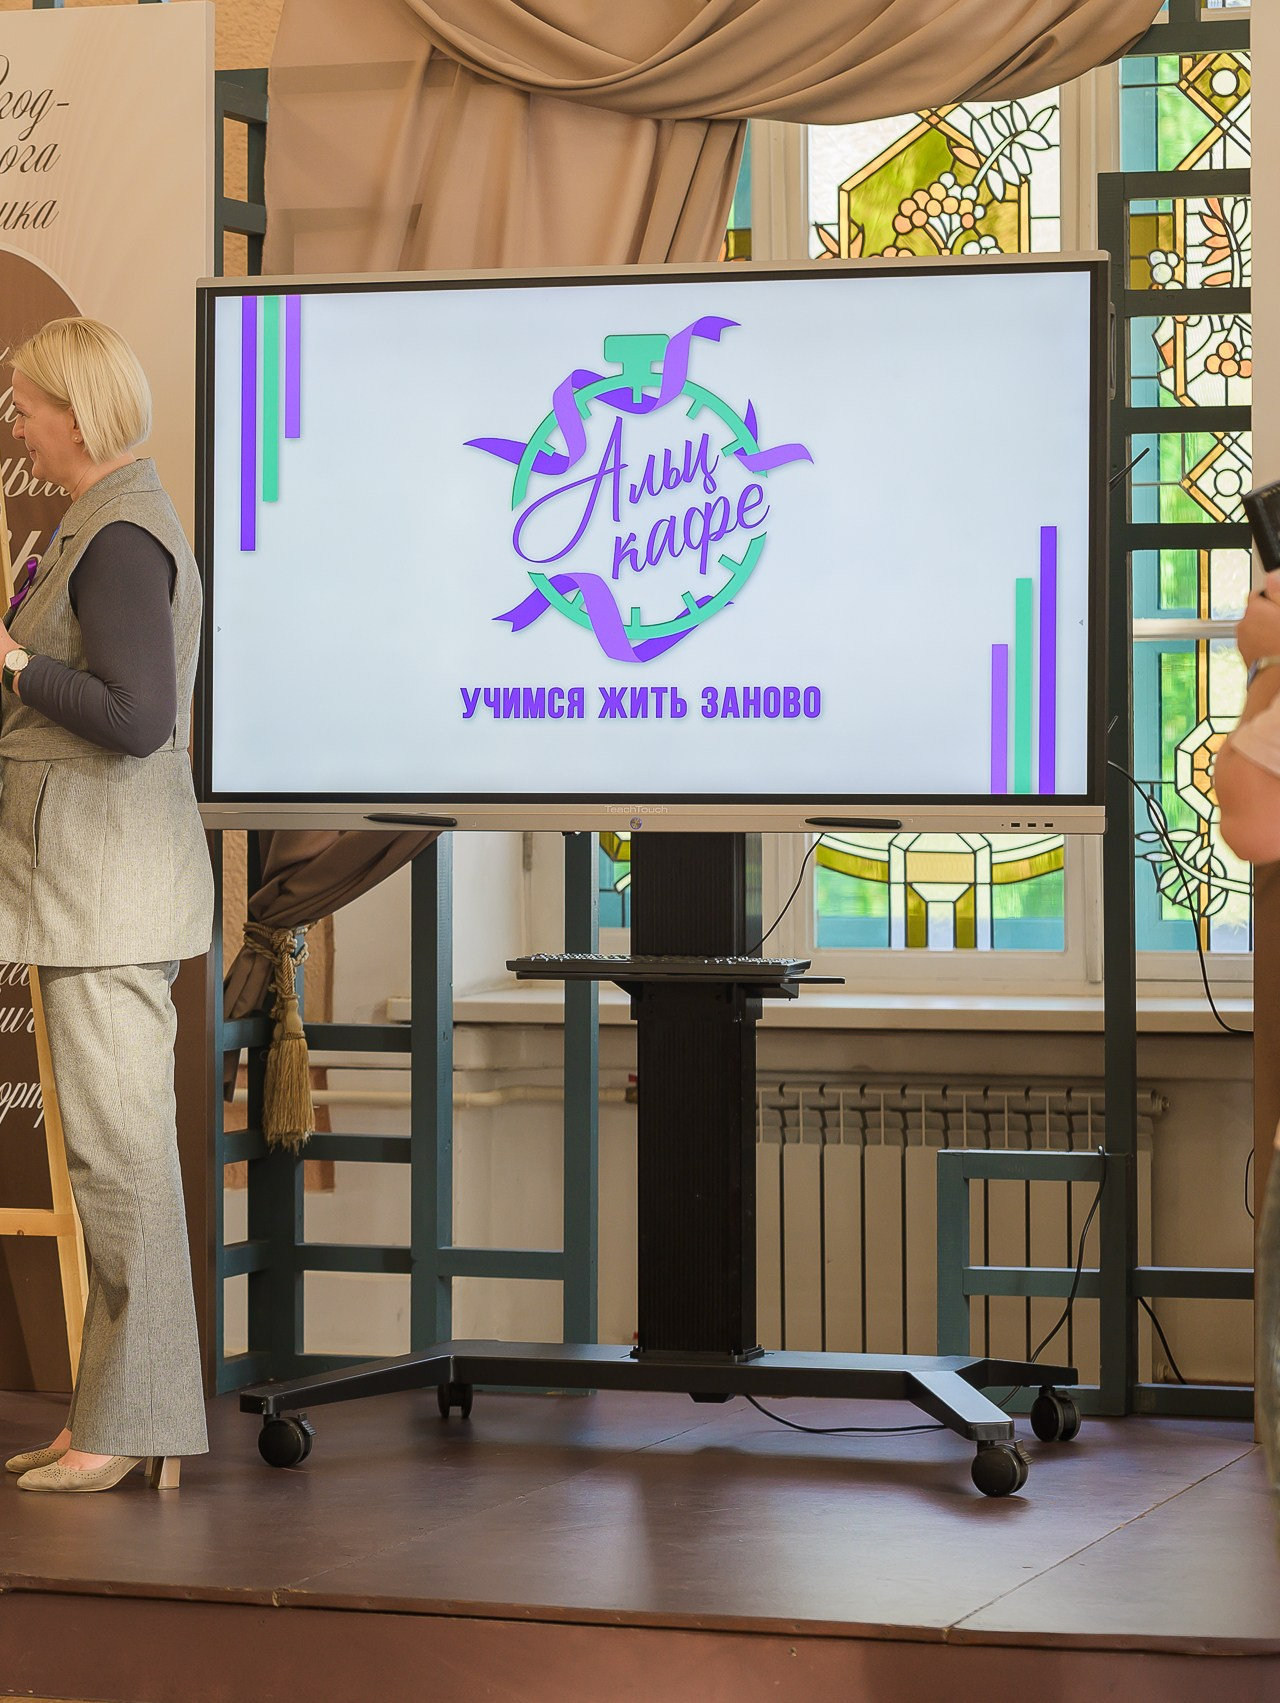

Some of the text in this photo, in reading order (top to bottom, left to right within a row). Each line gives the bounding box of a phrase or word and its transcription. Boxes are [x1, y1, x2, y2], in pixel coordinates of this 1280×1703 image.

[513, 416, 719, 563] Альц
[612, 484, 770, 580] кафе
[460, 686, 821, 719] УЧИМСЯ ЖИТЬ ЗАНОВО
[604, 805, 668, 814] TeachTouch
